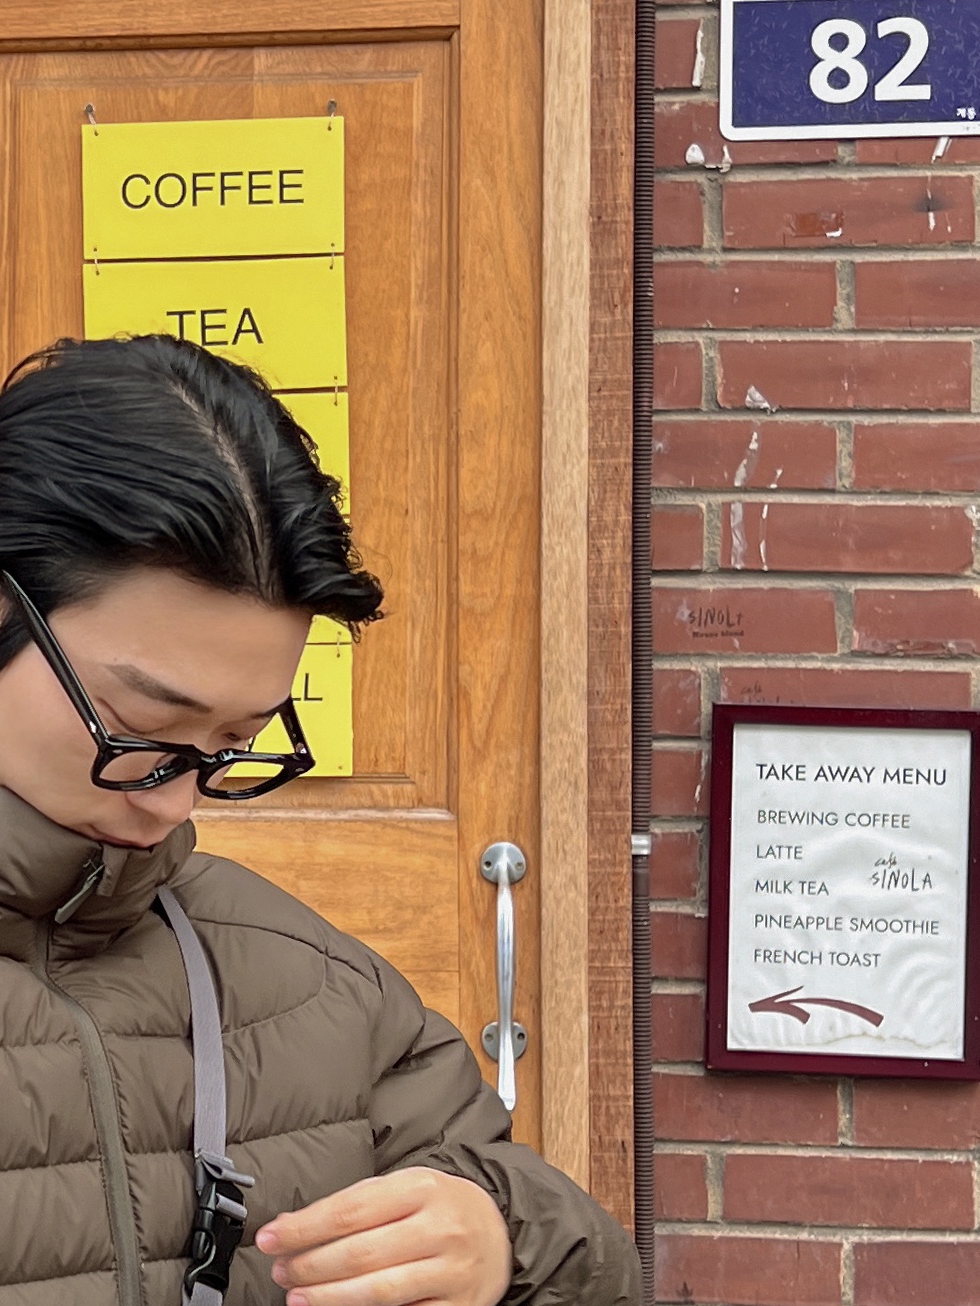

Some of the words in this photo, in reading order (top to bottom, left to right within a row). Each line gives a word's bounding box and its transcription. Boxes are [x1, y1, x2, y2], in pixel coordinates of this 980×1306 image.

[809, 17, 931, 103] 82
[121, 169, 304, 209] COFFEE
[166, 307, 264, 346] TEA
[755, 763, 807, 782] TAKE
[813, 765, 876, 783] AWAY
[882, 767, 947, 786] MENU
[757, 809, 839, 827] BREWING
[844, 812, 911, 829] COFFEE
[756, 844, 803, 860] LATTE
[755, 879, 793, 895] MILK
[798, 880, 830, 896] TEA
[754, 913, 844, 932] PINEAPPLE
[849, 917, 940, 936] SMOOTHIE
[753, 948, 823, 966] FRENCH
[828, 951, 881, 968] TOAST
